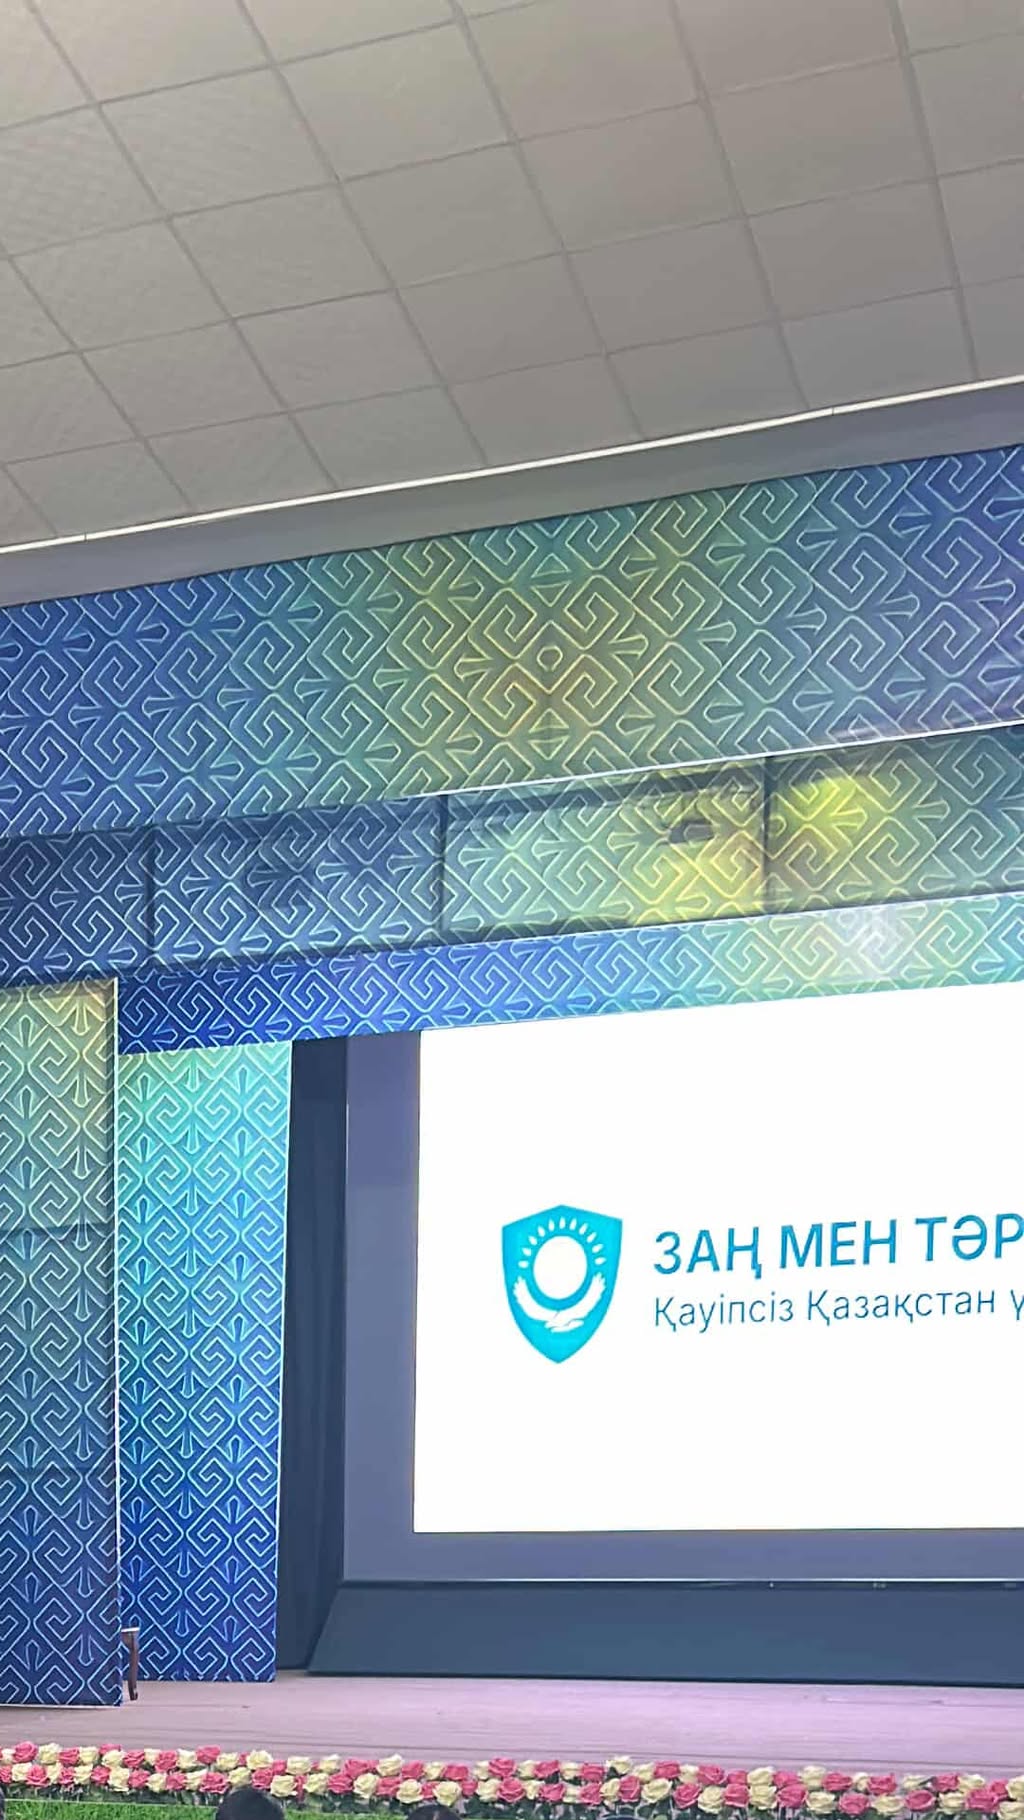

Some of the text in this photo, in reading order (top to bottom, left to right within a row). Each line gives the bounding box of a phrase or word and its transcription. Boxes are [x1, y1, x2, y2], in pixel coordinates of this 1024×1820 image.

[654, 1213, 1024, 1280] ЗАҢ МЕН ТӘР
[654, 1291, 794, 1334] Қауіпсіз
[807, 1290, 995, 1327] Қазақстан
